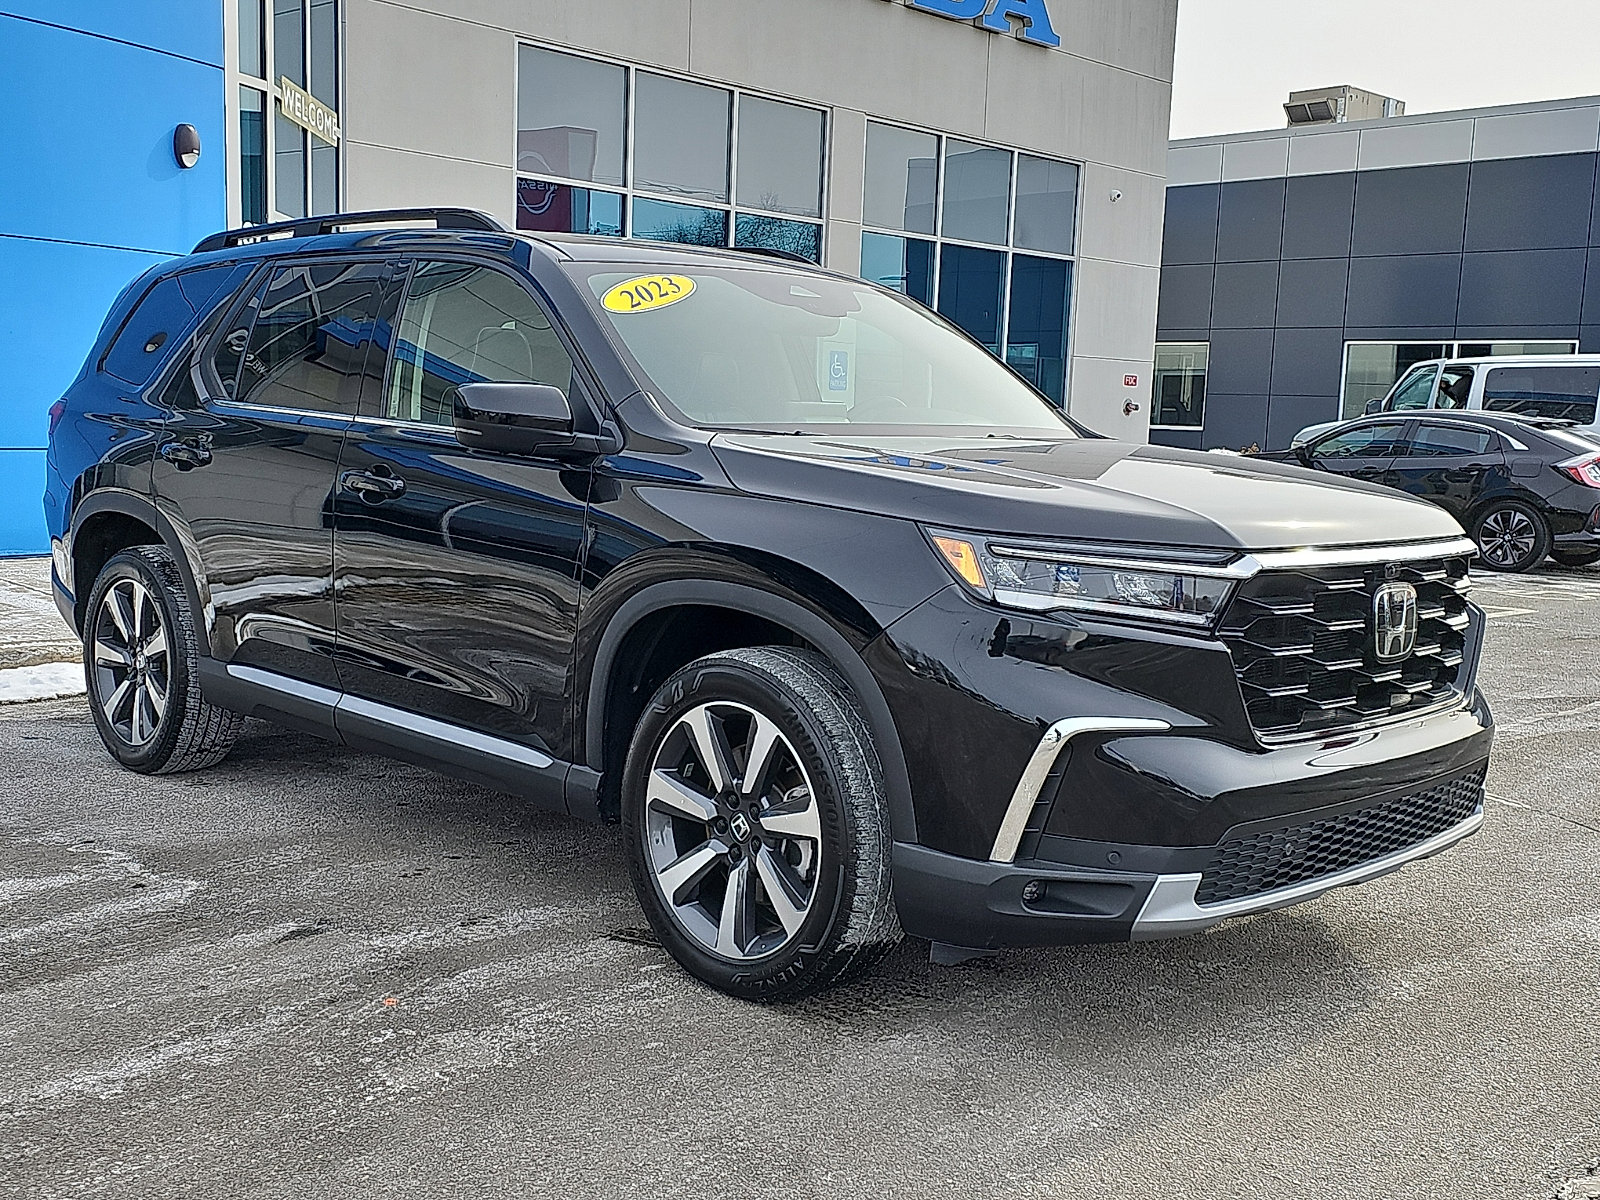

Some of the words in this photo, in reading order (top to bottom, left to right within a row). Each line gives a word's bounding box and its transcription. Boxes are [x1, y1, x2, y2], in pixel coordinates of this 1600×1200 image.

[282, 82, 338, 141] WELCOME
[619, 276, 682, 309] 2023
[1125, 376, 1137, 386] FDC
